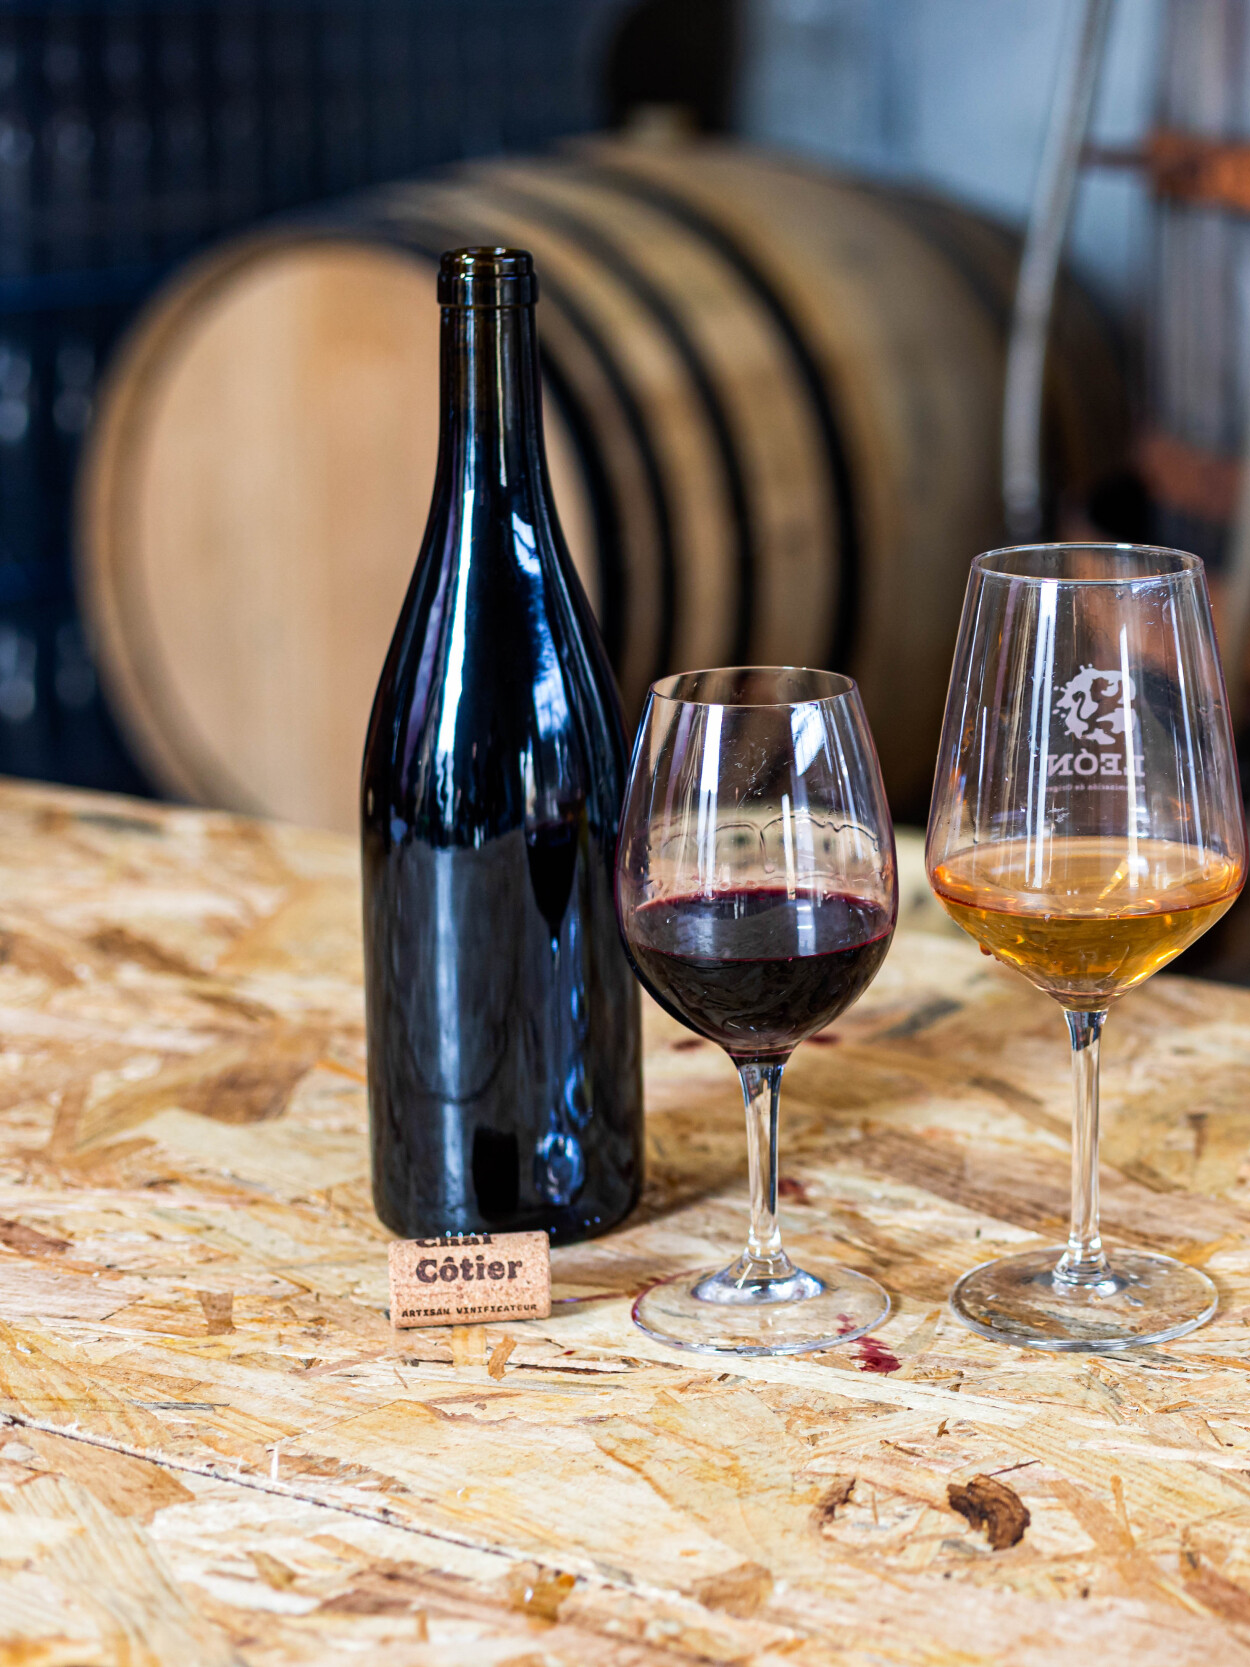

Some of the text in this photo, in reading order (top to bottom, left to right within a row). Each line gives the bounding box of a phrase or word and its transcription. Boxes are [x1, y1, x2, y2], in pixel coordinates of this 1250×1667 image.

[416, 1255, 522, 1283] Côtier
[401, 1303, 538, 1318] ARTISAN VINIFICATEUR
